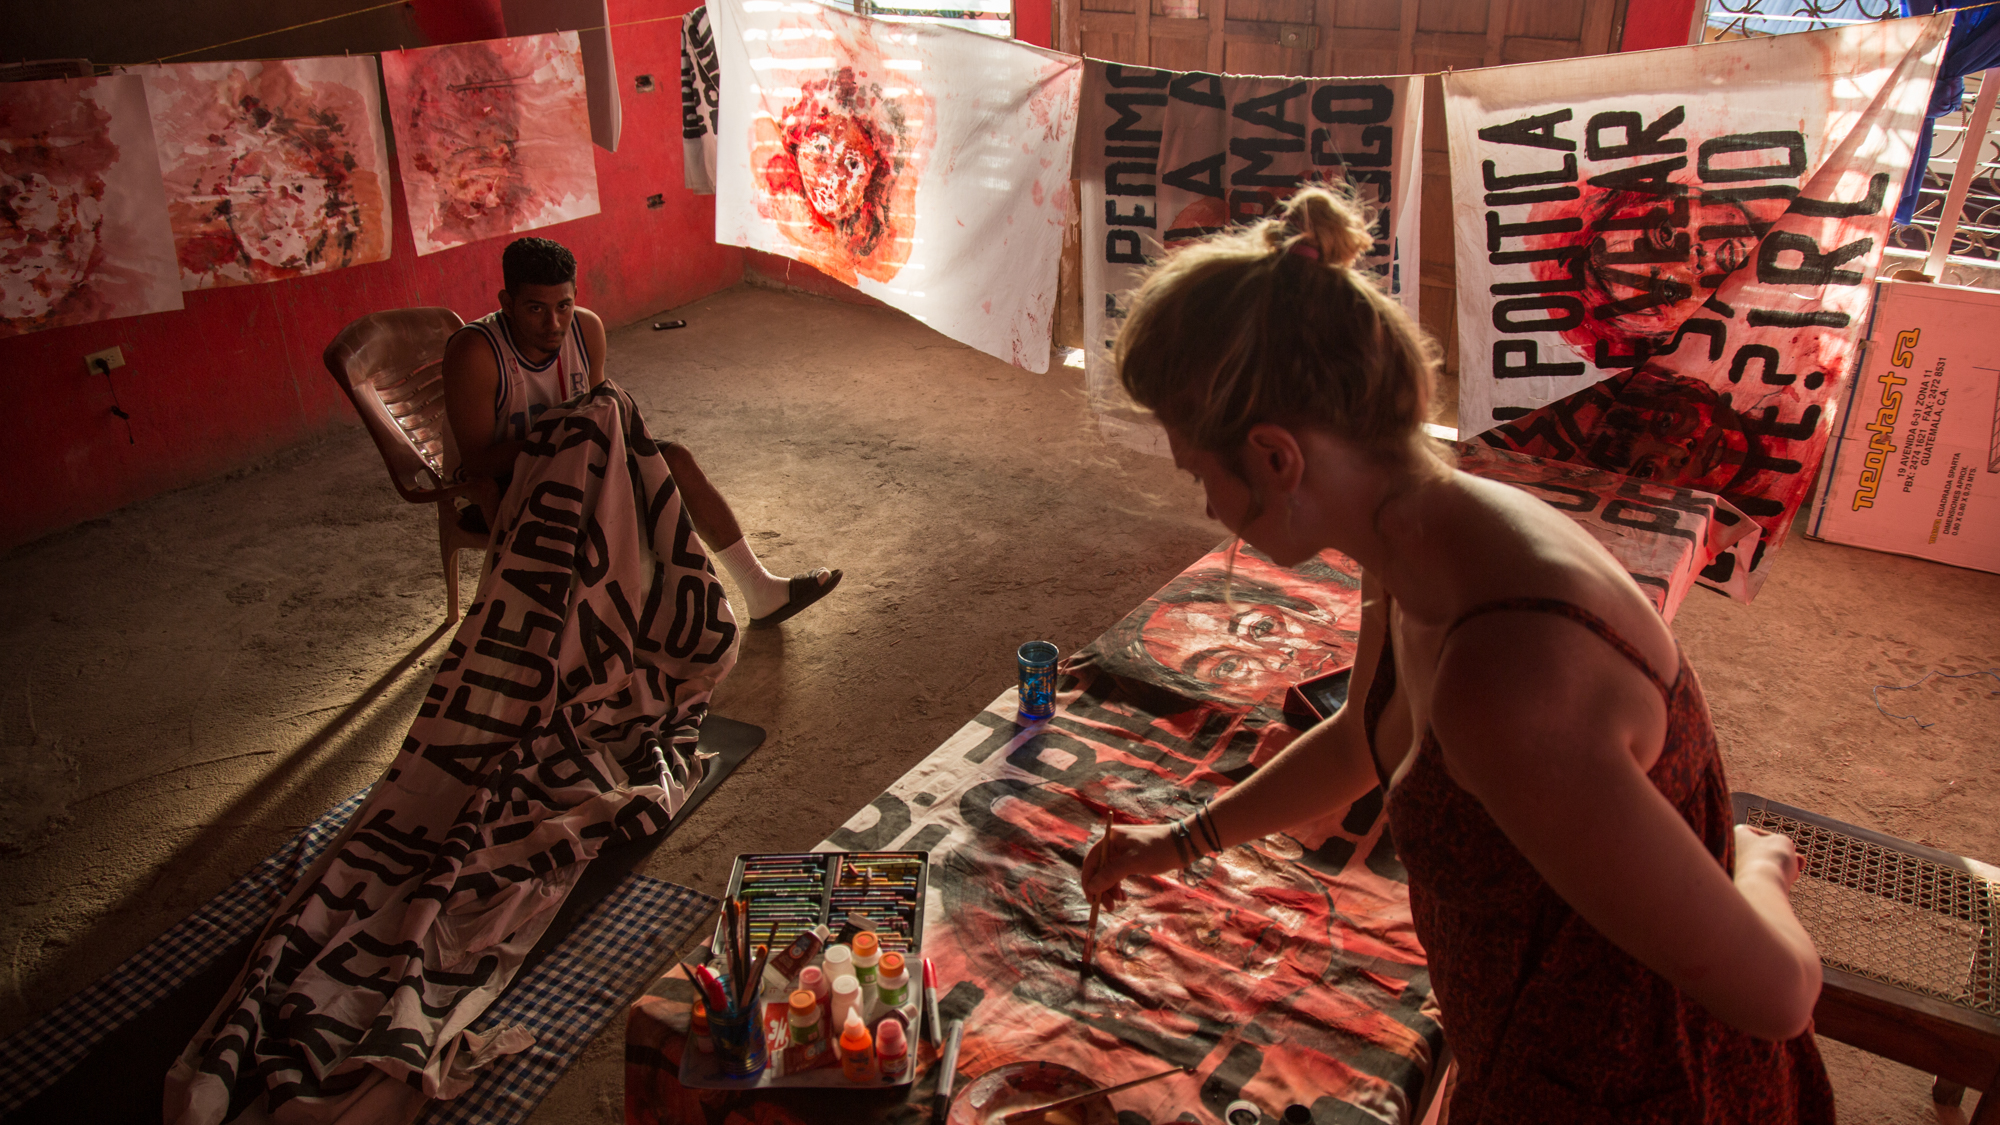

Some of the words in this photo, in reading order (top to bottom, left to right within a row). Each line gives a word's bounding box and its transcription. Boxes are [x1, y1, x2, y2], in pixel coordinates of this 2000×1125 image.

[1478, 107, 1586, 380] POLITICA
[1924, 369, 1933, 380] 11
[1934, 356, 1946, 377] 8531
[1916, 380, 1930, 407] ZONA
[1928, 378, 1941, 400] 2472
[1852, 370, 1907, 512] neoplast
[1891, 327, 1922, 369] sa
[1911, 408, 1922, 427] 6-31
[1922, 400, 1935, 422] FAX:
[1920, 407, 1944, 467] GUATEMALA,
[1937, 386, 1949, 407] C.A.
[1900, 427, 1917, 467] AVENIDA
[1915, 428, 1927, 448] 1621
[1909, 449, 1922, 471] 2474
[1897, 467, 1906, 478] 19
[1903, 472, 1915, 493] PBX:
[1936, 479, 1953, 518] CUADRADA
[1947, 452, 1961, 479] SPARTA
[1943, 489, 1962, 535] DIMENSIONES
[1956, 464, 1969, 489] APROX.
